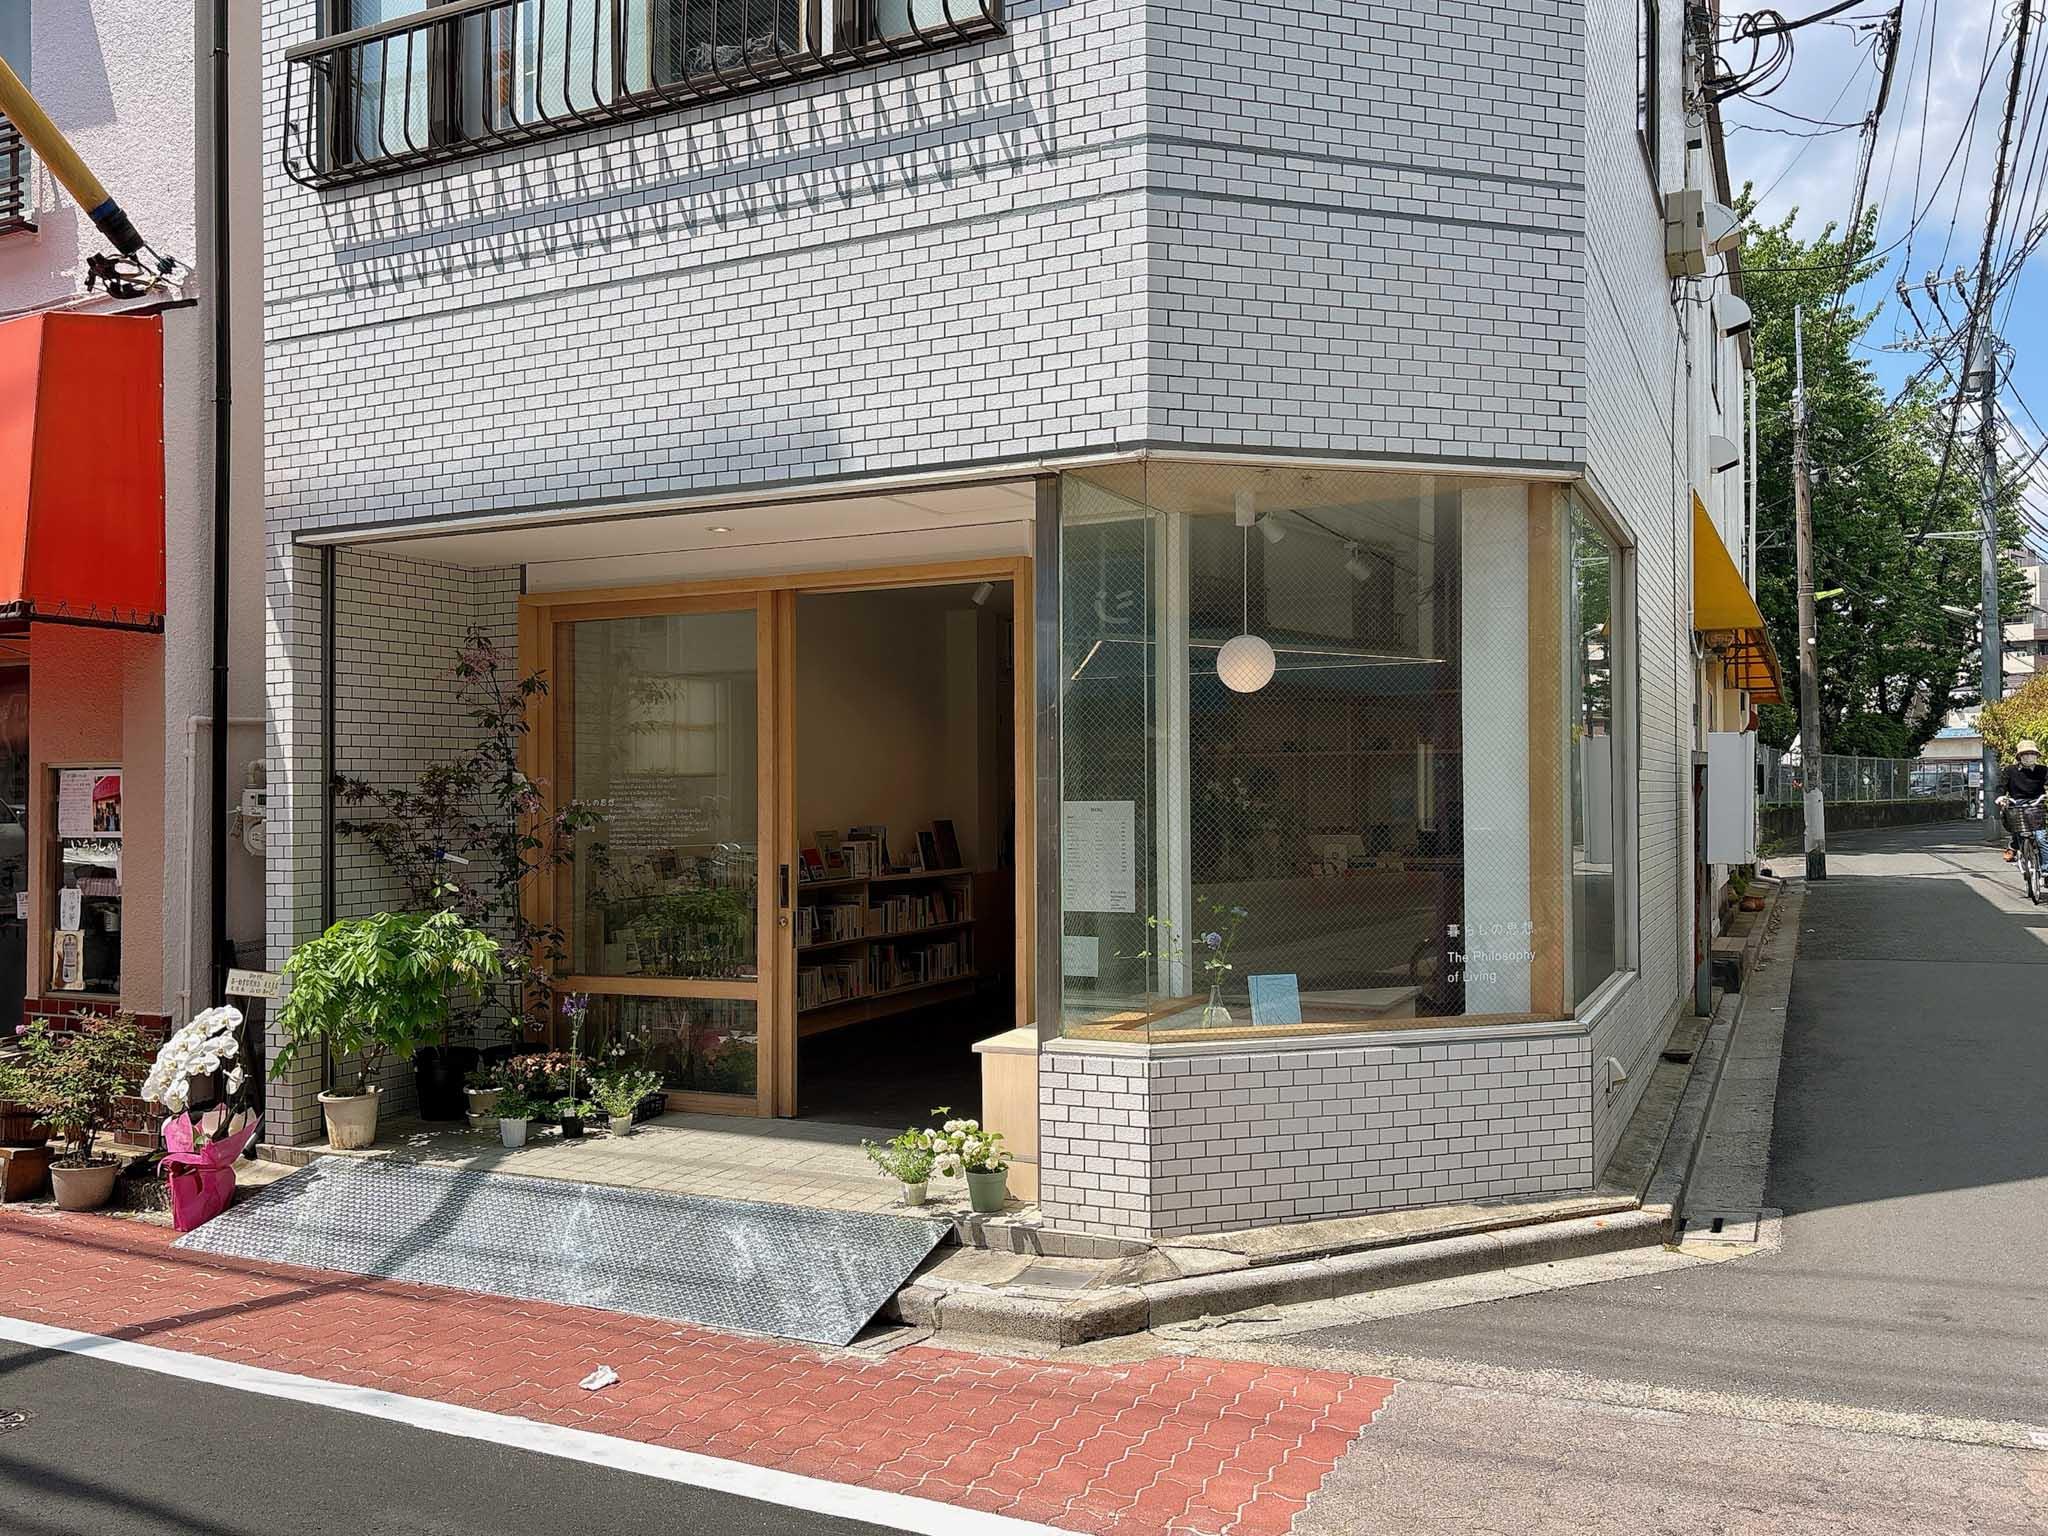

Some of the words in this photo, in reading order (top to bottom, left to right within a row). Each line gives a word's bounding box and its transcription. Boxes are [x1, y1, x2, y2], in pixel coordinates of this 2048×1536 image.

[1447, 920, 1534, 938] 暮らしの思想
[1447, 951, 1469, 963] The
[1473, 949, 1536, 963] Philosophy
[1447, 971, 1460, 983] of
[1463, 971, 1497, 984] Living
